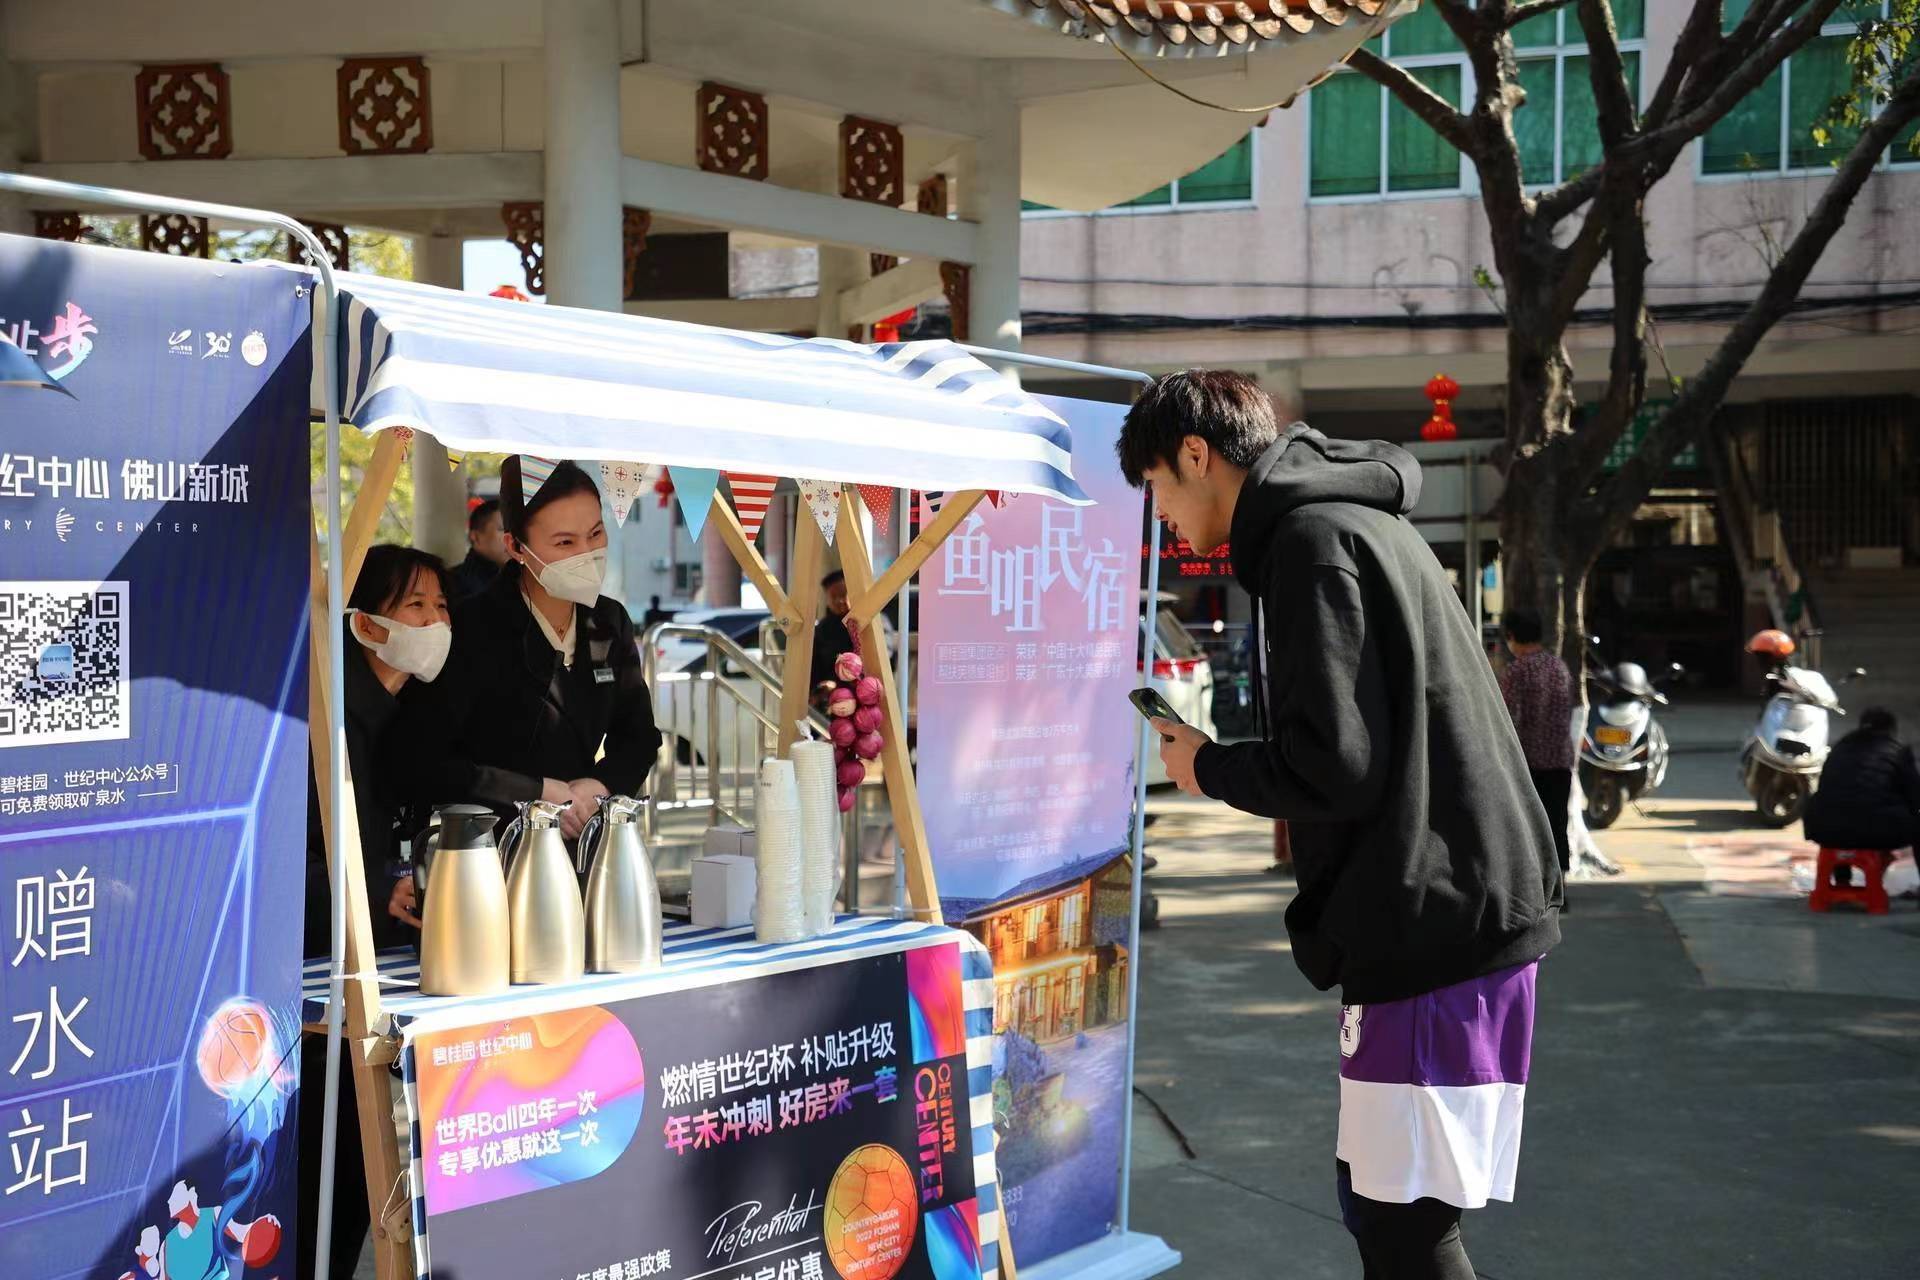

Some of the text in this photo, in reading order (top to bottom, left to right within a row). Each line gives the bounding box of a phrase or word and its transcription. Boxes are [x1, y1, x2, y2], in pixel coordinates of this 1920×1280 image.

[121, 459, 249, 502] 佛山新城
[96, 521, 199, 533] CENTER
[1, 788, 125, 816] 可免费领取矿泉水
[6, 865, 95, 1195] 赠水站
[660, 1022, 896, 1109] 燃情世纪杯 补贴升级
[435, 1089, 598, 1146] 世界Ball四年一次
[664, 1066, 898, 1156] 年末冲刺 好房来一套
[914, 1067, 944, 1204] CENTER
[438, 1120, 601, 1177] 专享优惠就这一次
[733, 1251, 824, 1280] 优惠
